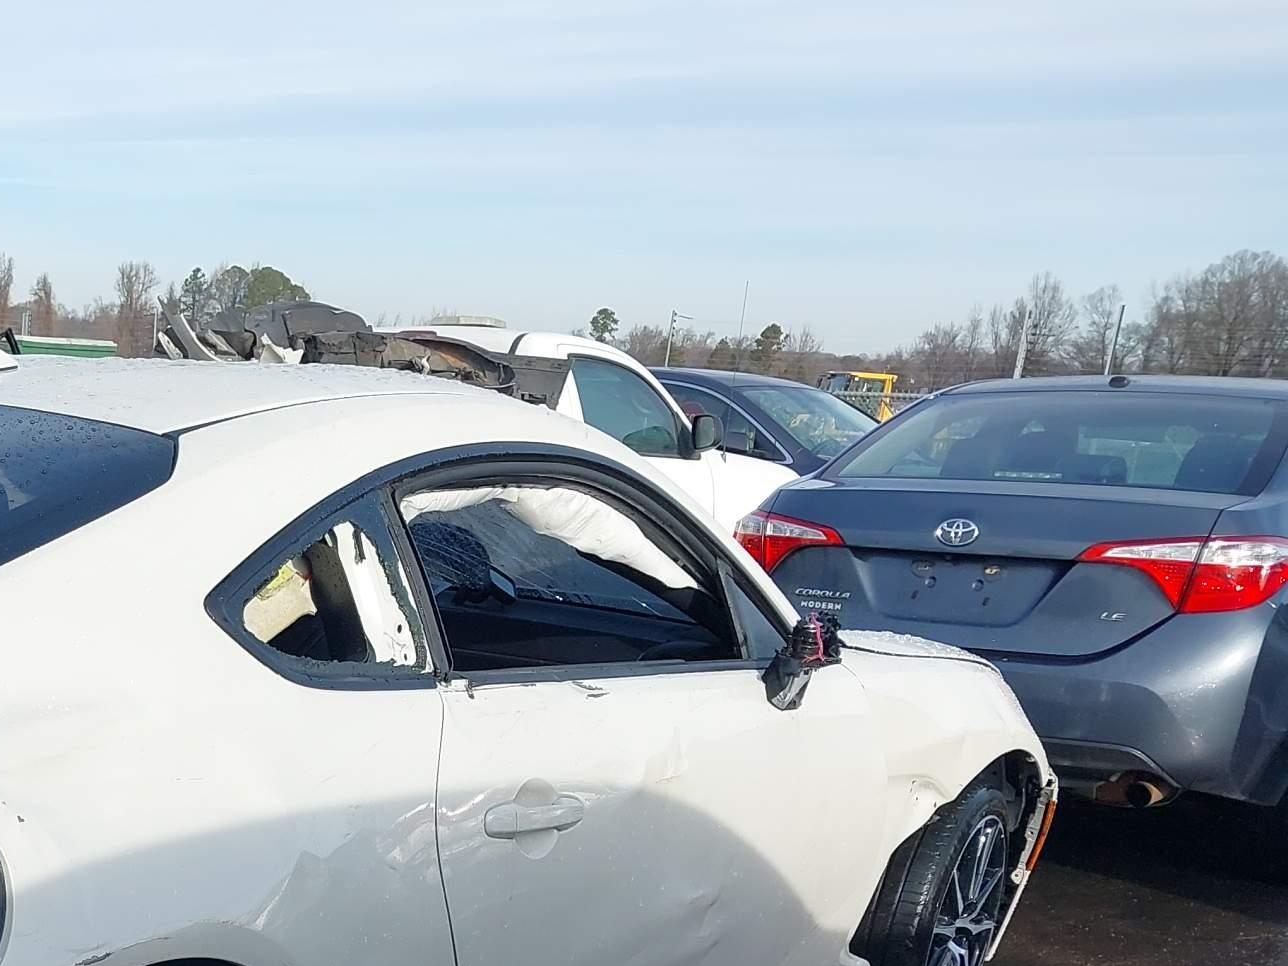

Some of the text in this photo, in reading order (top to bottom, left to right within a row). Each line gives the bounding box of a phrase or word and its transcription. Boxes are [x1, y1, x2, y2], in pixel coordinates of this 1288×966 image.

[795, 588, 851, 599] COROLLA
[800, 600, 842, 610] MODERN
[1100, 611, 1127, 621] LE
